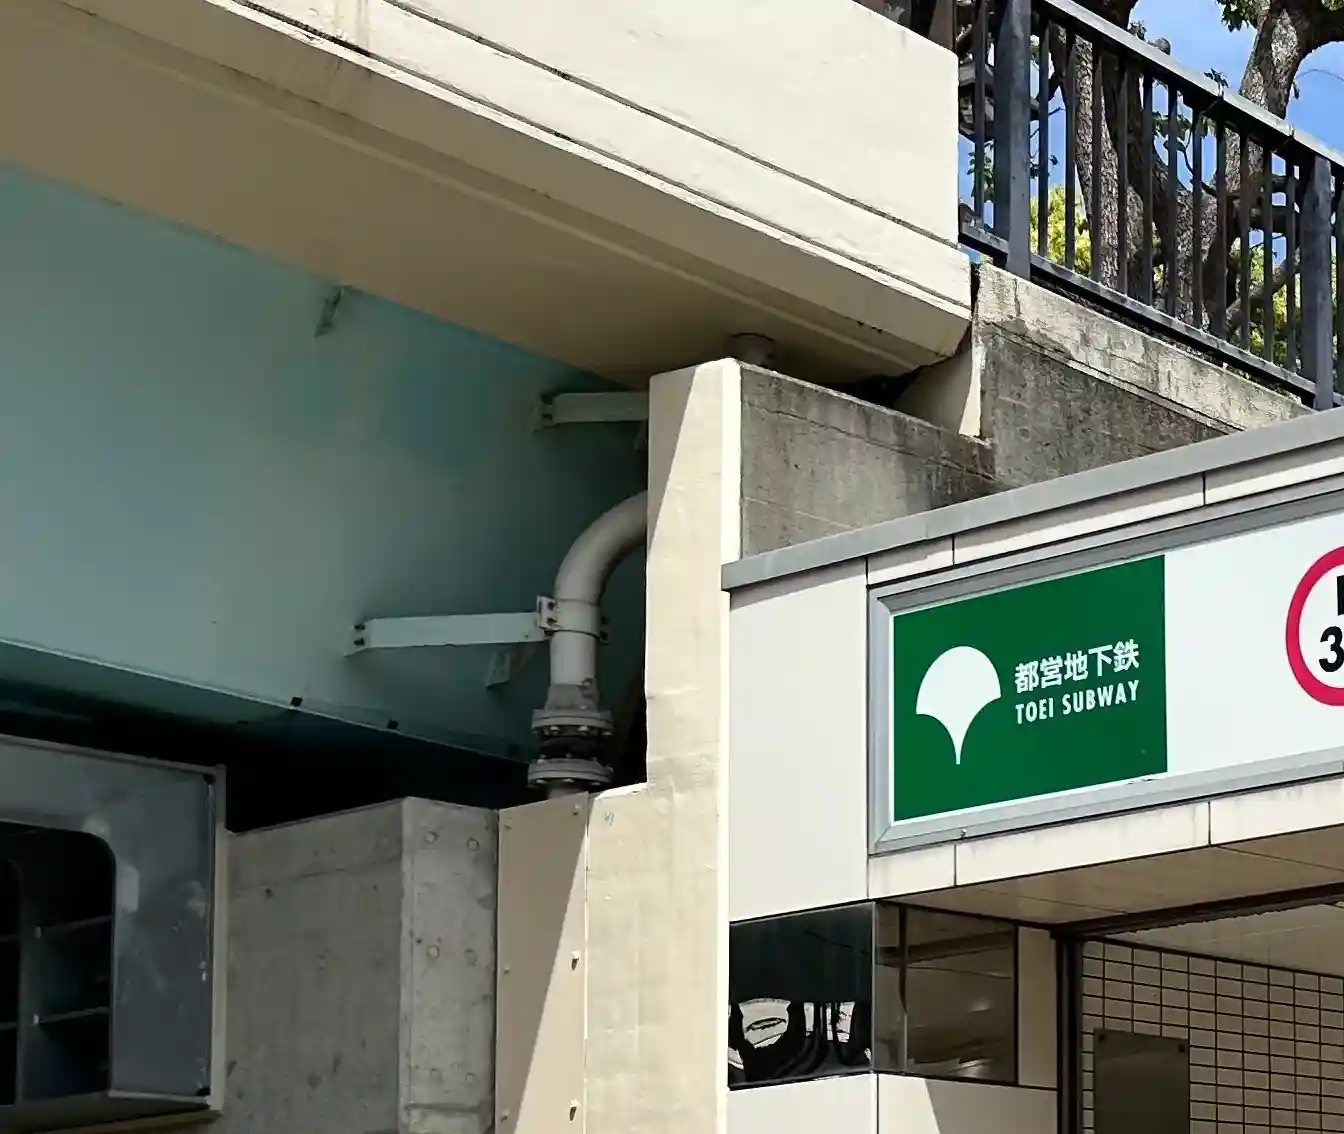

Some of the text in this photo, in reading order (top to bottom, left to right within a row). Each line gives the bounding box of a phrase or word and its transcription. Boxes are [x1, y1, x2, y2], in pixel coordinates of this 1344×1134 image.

[1014, 638, 1140, 694] 都営地下鉄
[1015, 679, 1139, 724] TOEI SUBWAY
